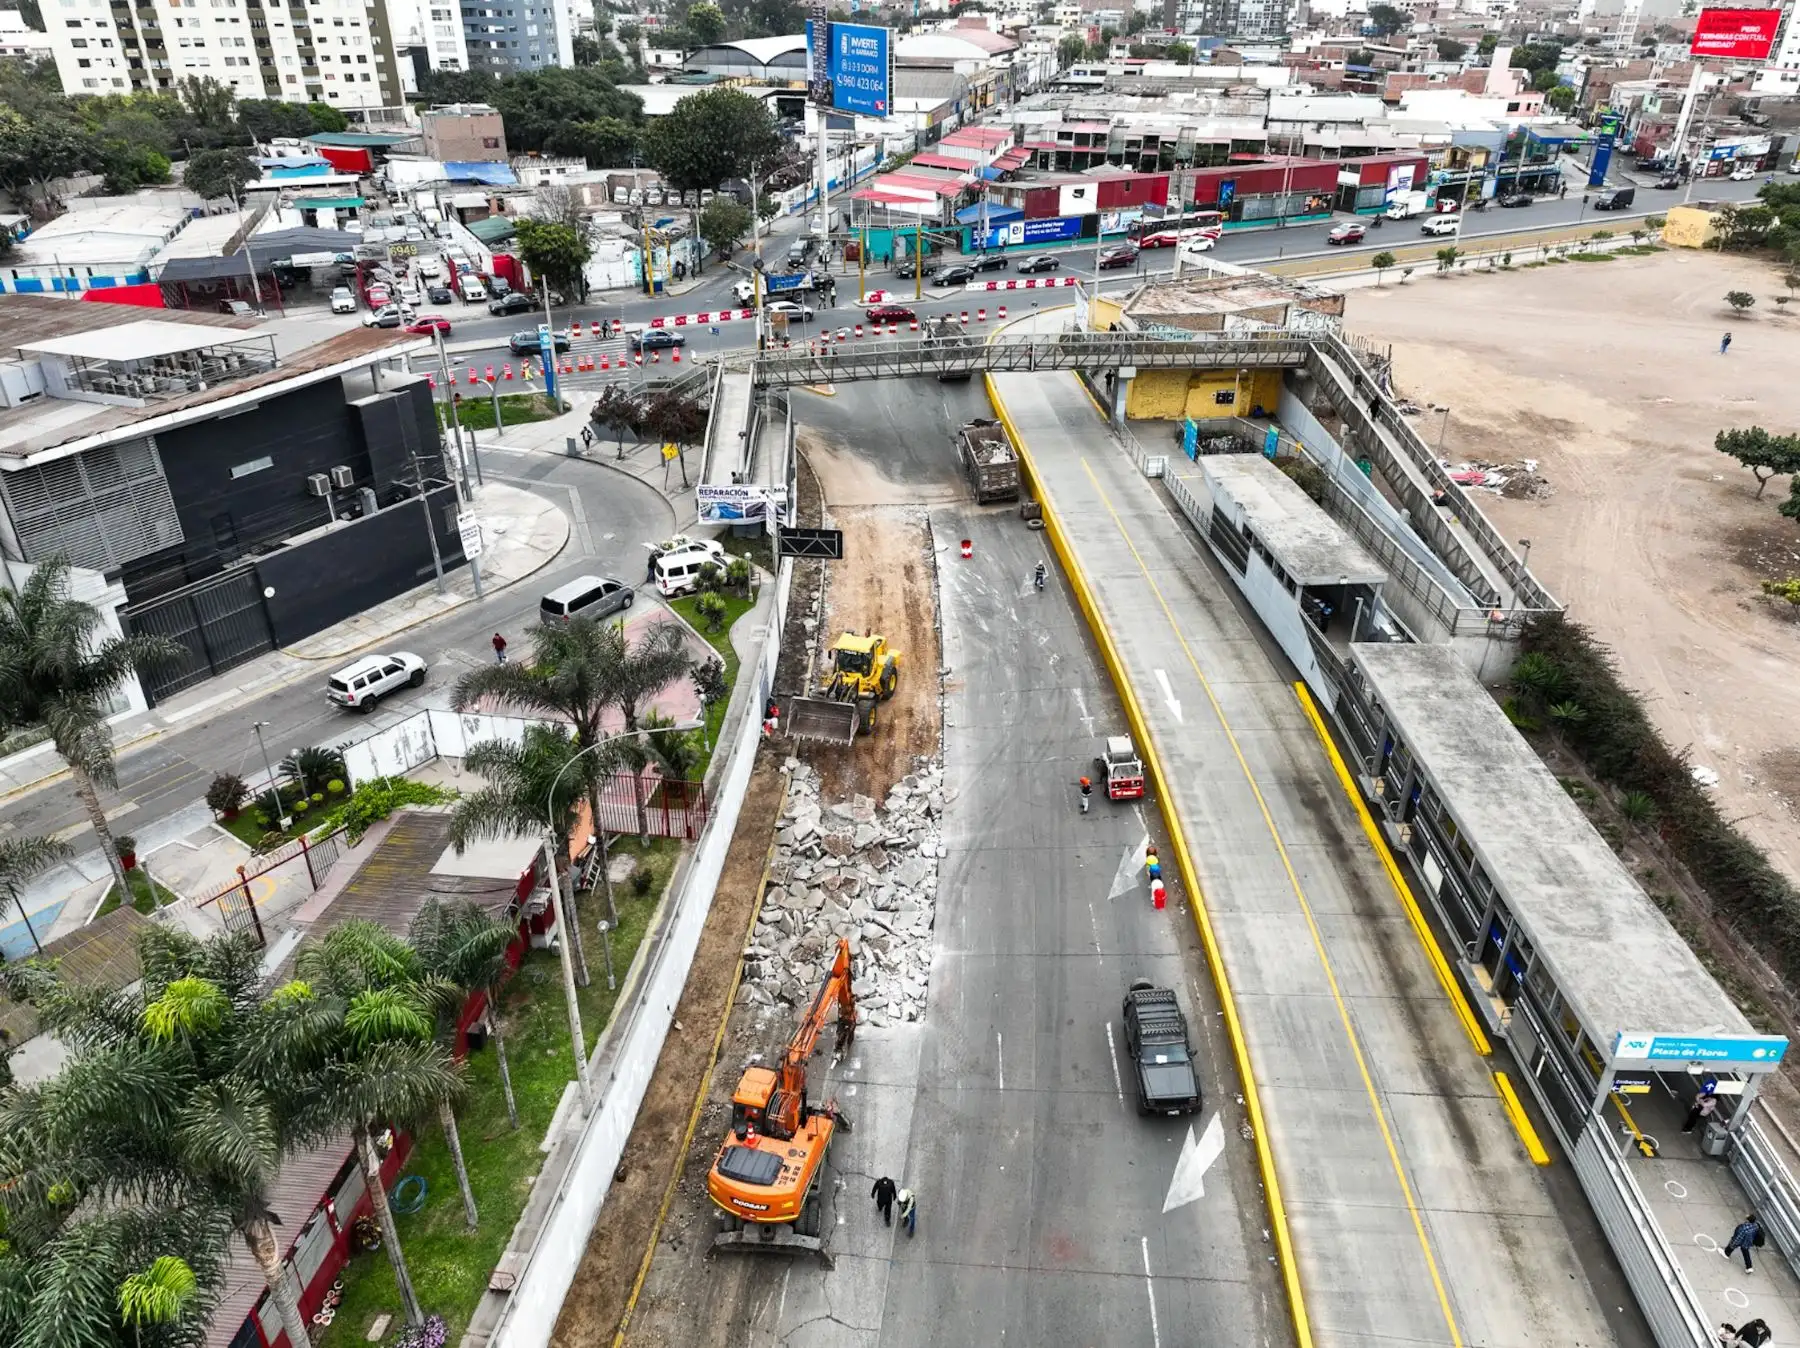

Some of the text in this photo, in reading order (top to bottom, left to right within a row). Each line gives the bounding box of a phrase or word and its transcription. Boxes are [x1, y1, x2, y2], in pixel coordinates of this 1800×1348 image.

[851, 37, 878, 50] INVIERTE
[1748, 34, 1766, 42] FULL
[844, 76, 884, 91] 960 423 064
[390, 244, 417, 256] 6949
[698, 488, 748, 496] REPARACIÓN
[1652, 1048, 1680, 1056] Plaza
[1696, 1049, 1728, 1057] Flores
[733, 1198, 767, 1210] DOOSAN
